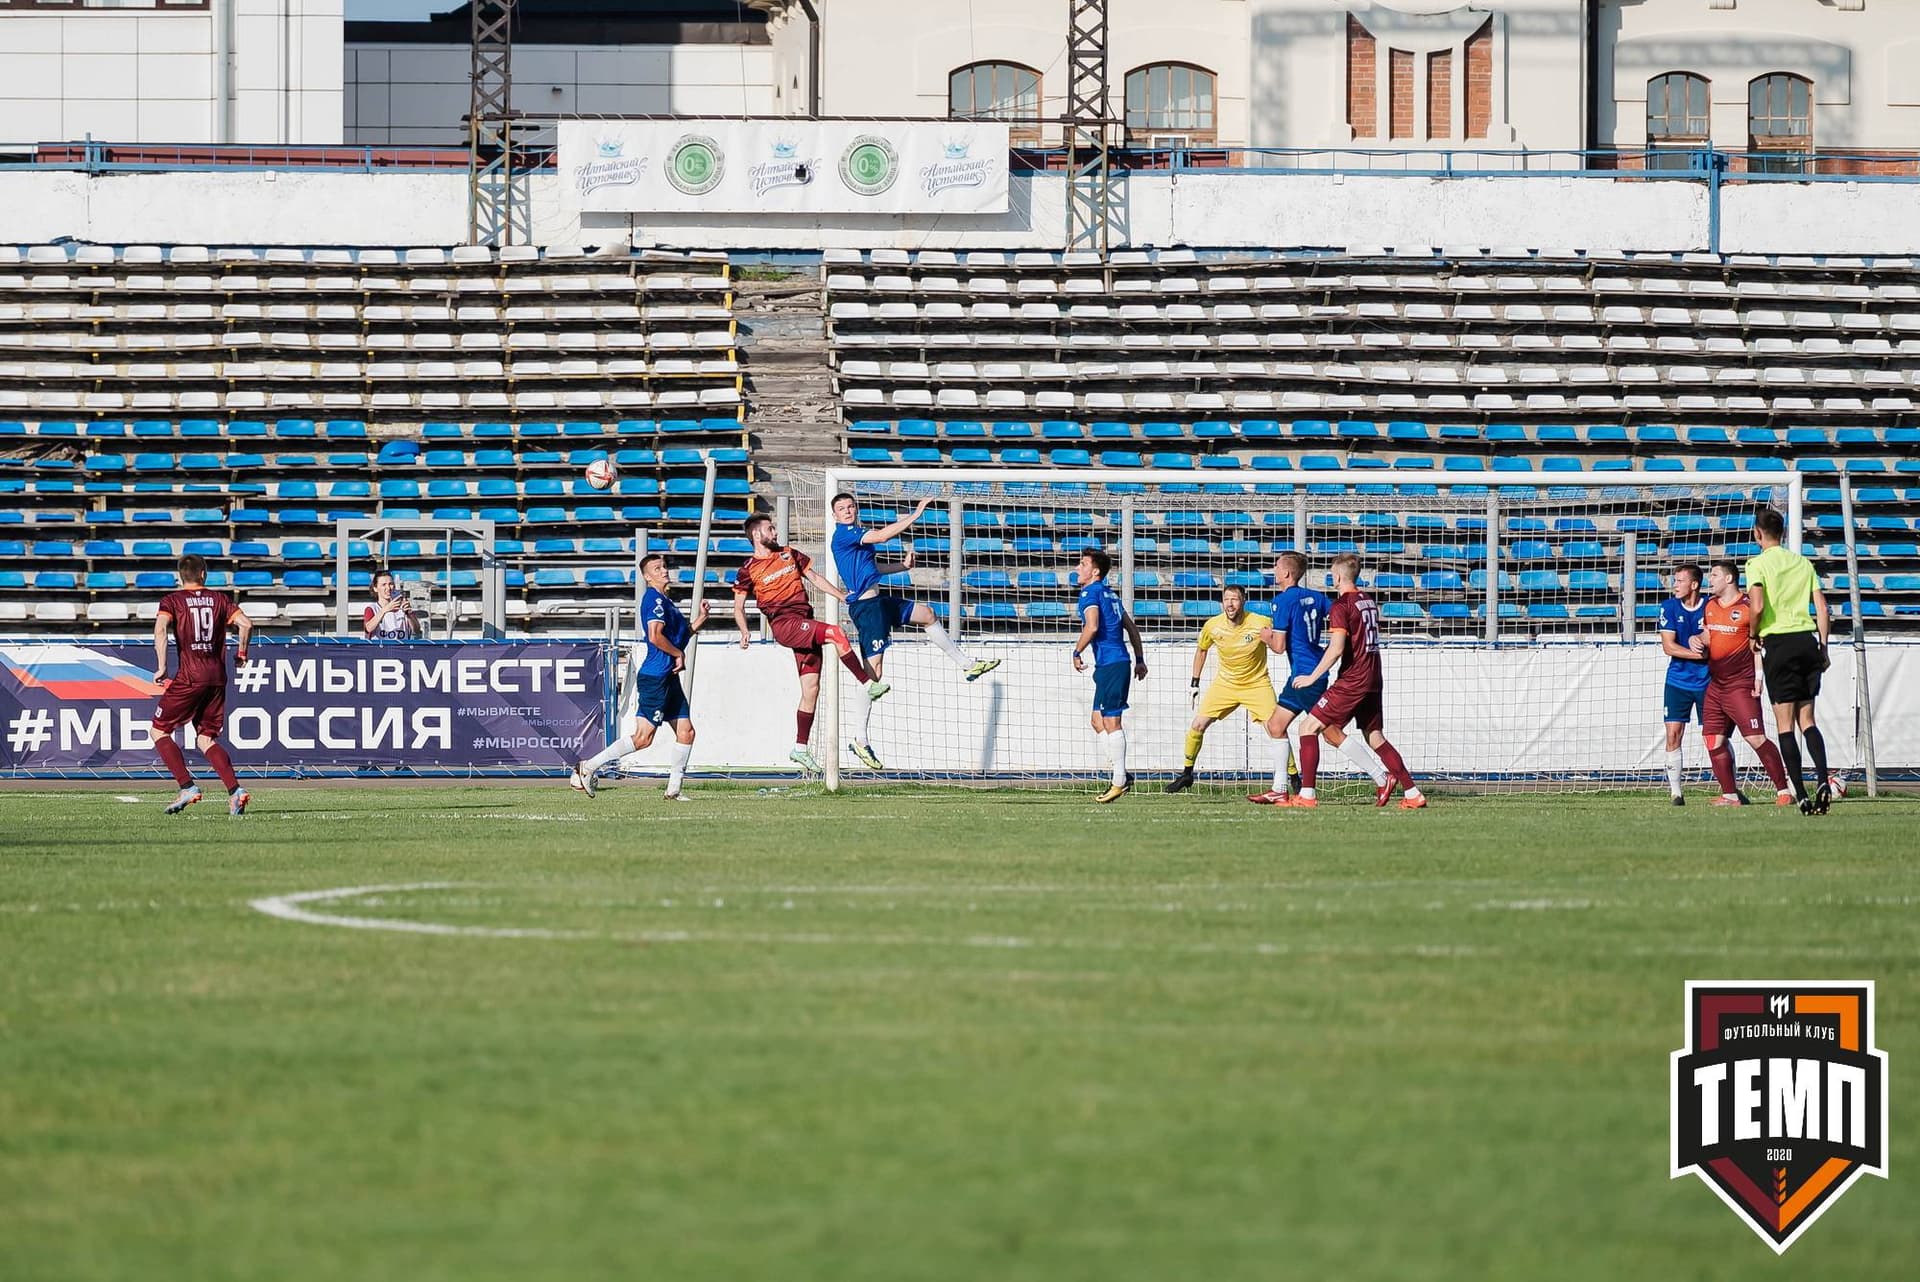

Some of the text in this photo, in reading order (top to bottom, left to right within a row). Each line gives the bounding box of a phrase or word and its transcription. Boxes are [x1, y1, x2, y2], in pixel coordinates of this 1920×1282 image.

[189, 607, 214, 642] 19
[1303, 608, 1318, 643] 11
[234, 658, 586, 694] #МЫВМЕСТЕ
[456, 706, 541, 717] #МЫВМЕСТЕ
[472, 736, 585, 750] #МЫРОССИЯ
